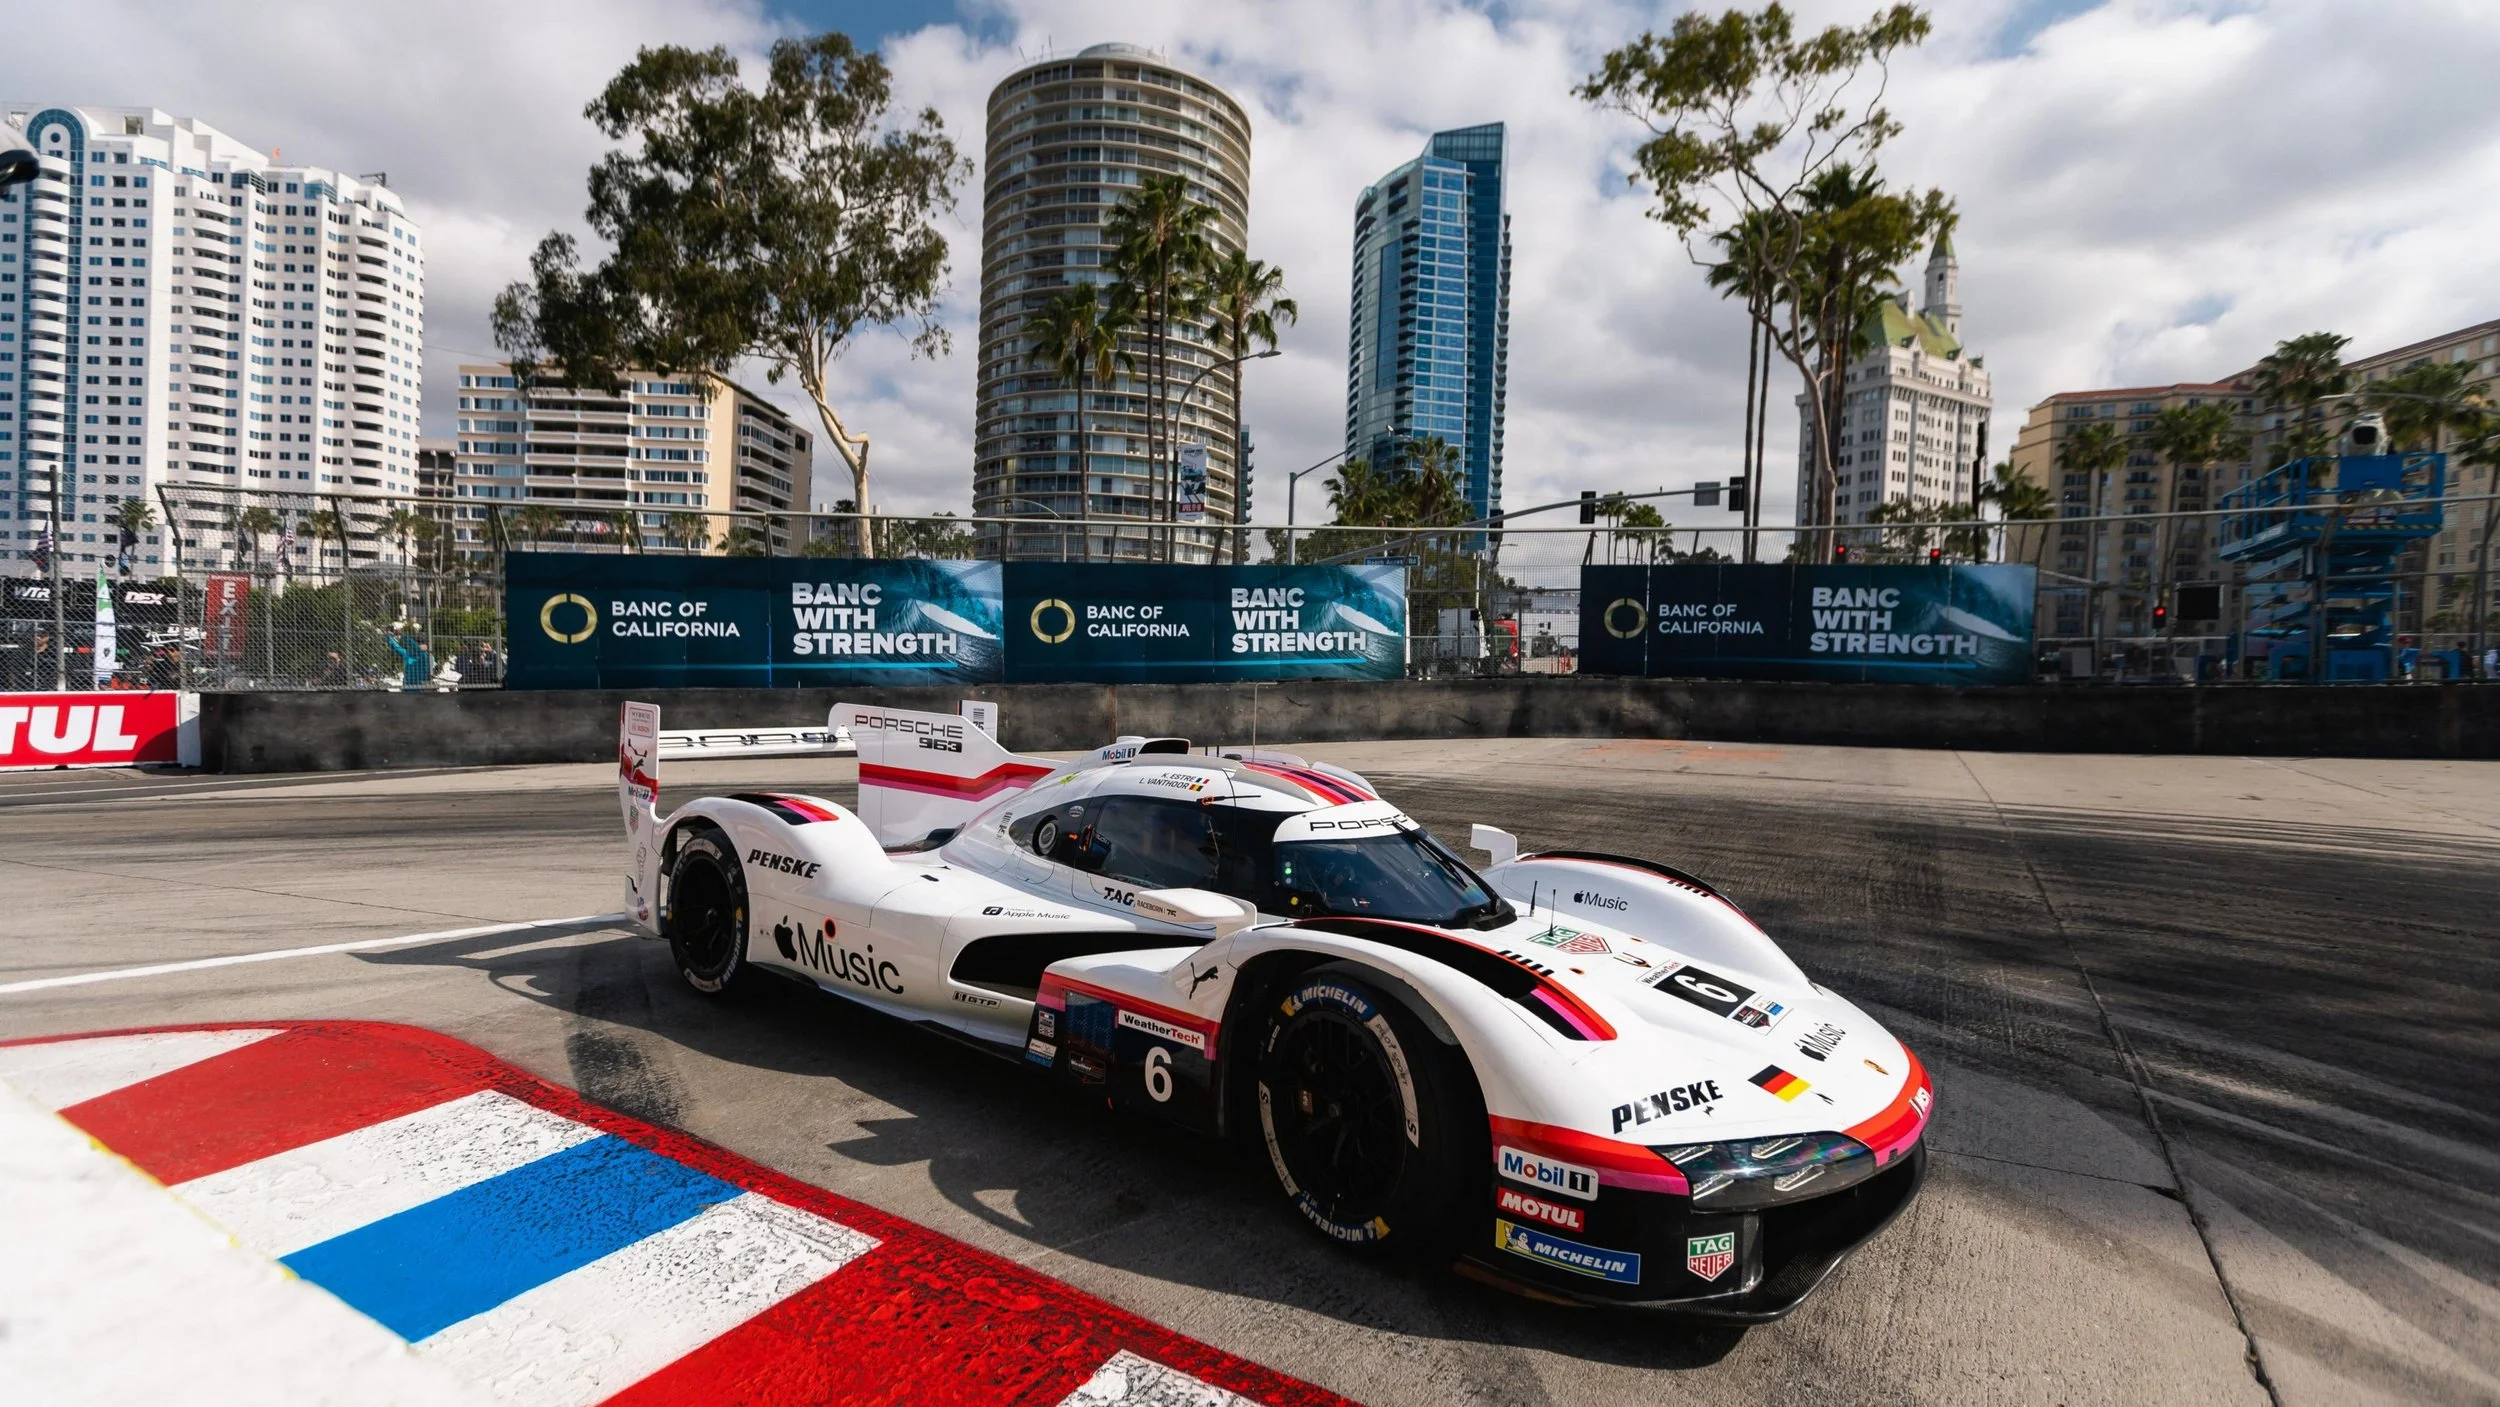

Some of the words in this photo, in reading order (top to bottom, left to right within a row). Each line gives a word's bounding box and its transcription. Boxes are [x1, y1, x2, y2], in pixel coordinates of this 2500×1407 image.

[124, 591, 165, 606] DEX
[792, 582, 882, 606] BANC
[1231, 588, 1305, 608] BANC
[1812, 587, 1900, 608] BANC
[219, 581, 238, 650] EXIT
[612, 601, 672, 617] BANC
[678, 602, 707, 617] OF
[793, 607, 876, 630] WITH
[1087, 606, 1138, 619] BANC
[1141, 606, 1164, 619] OF
[1658, 604, 1708, 617] BANC
[1712, 604, 1737, 617] OF
[612, 621, 741, 638] CALIFORNIA
[1087, 623, 1190, 638] CALIFORNIA
[1232, 610, 1299, 631] WITH
[1658, 620, 1765, 635] CALIFORNIA
[1810, 610, 1892, 632] WITH
[792, 632, 957, 656] STRENGTH
[1231, 632, 1367, 653] STRENGTH
[1808, 633, 1978, 656] STRENGTH
[0, 705, 138, 754] TUL
[855, 714, 963, 739] PORSCHE
[919, 737, 963, 753] 963
[1102, 749, 1126, 761] Mobil
[1148, 778, 1189, 790] VANTHOOR
[1170, 773, 1196, 782] ESTRE
[747, 849, 822, 879] PENSKE
[1104, 887, 1135, 906] TAG
[1583, 891, 1629, 911] Music
[1003, 910, 1035, 918] Apple
[1037, 912, 1071, 920] Music
[797, 922, 904, 994] Music
[1641, 961, 1681, 984] WeatherTech
[1302, 984, 1368, 1014] MICHELIN
[1674, 974, 1739, 1003] 6
[968, 996, 998, 1006] GTP
[1124, 1013, 1200, 1045] WeatherTech
[1799, 1022, 1846, 1056] Music
[1375, 1023, 1397, 1049] PILOT
[1391, 1050, 1408, 1086] SPORT
[1144, 1046, 1173, 1102] 6
[1260, 1089, 1269, 1104] S
[1611, 1079, 1724, 1135] PENSKE
[1406, 1119, 1417, 1136] S
[1504, 1152, 1565, 1187] Mobil
[1299, 1200, 1364, 1242] MICHELIN
[1501, 1192, 1580, 1228] MOTUL
[1692, 1236, 1730, 1253] TAG
[1533, 1242, 1627, 1273] MICHELIN
[1690, 1253, 1731, 1280] HEUER
